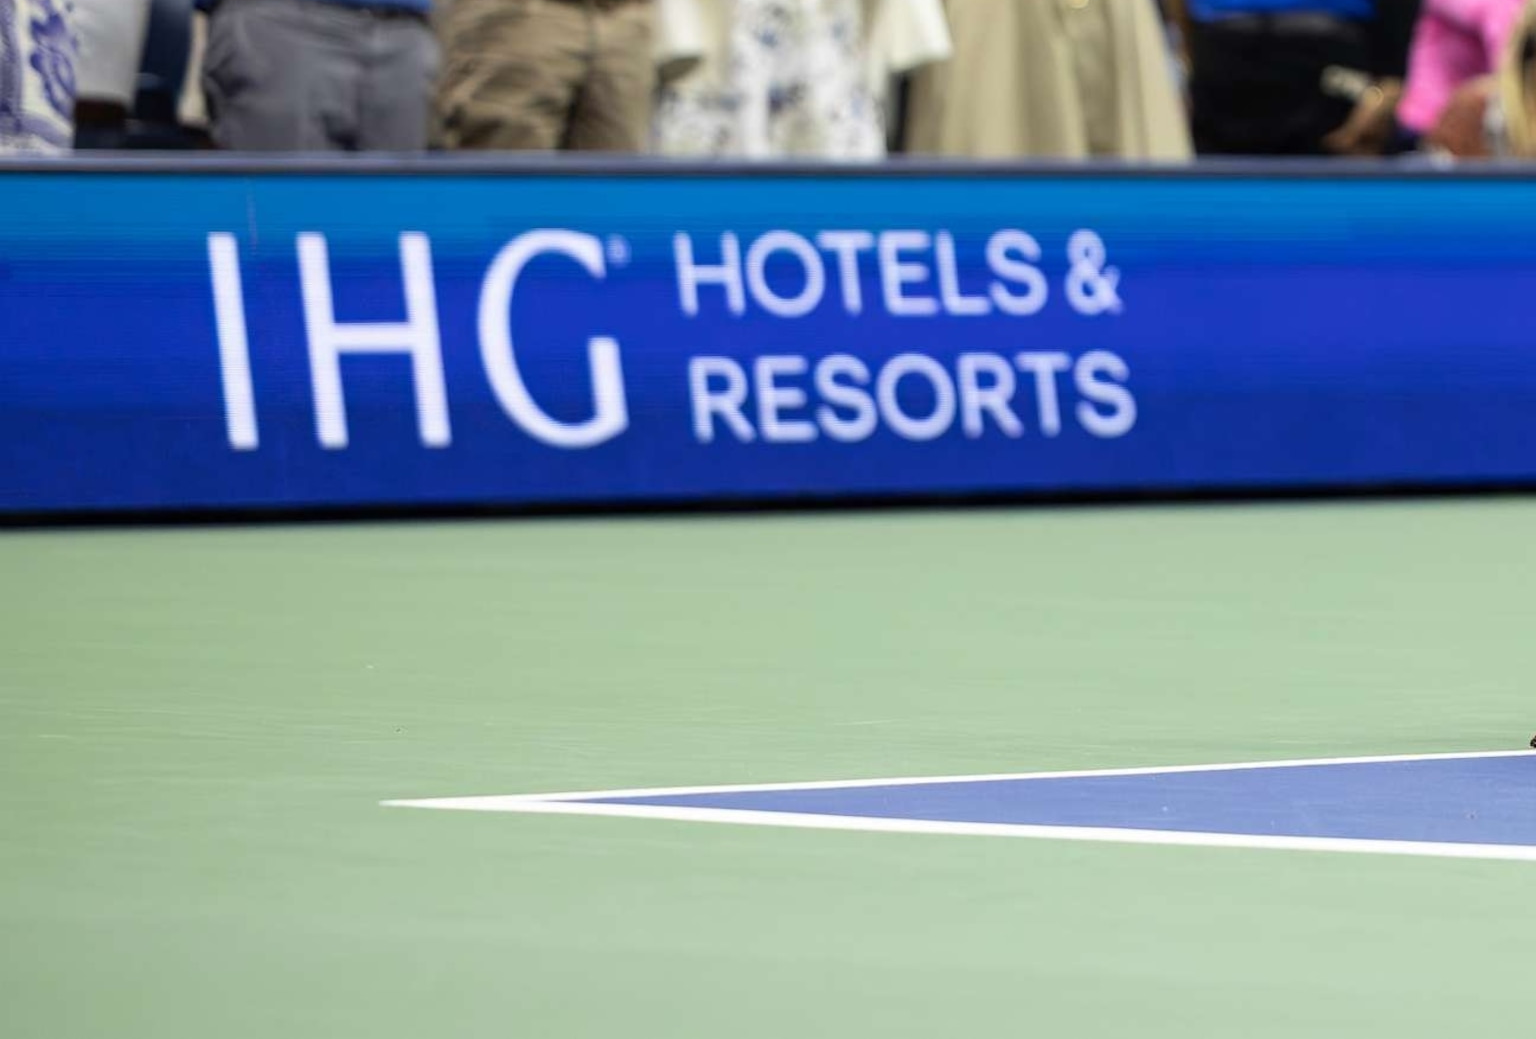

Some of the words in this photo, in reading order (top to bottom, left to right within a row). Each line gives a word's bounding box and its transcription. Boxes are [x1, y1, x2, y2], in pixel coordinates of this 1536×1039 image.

[675, 230, 1046, 315] HOTELS
[1066, 230, 1120, 315] &
[207, 229, 628, 449] IHG
[690, 352, 1134, 440] RESORTS
